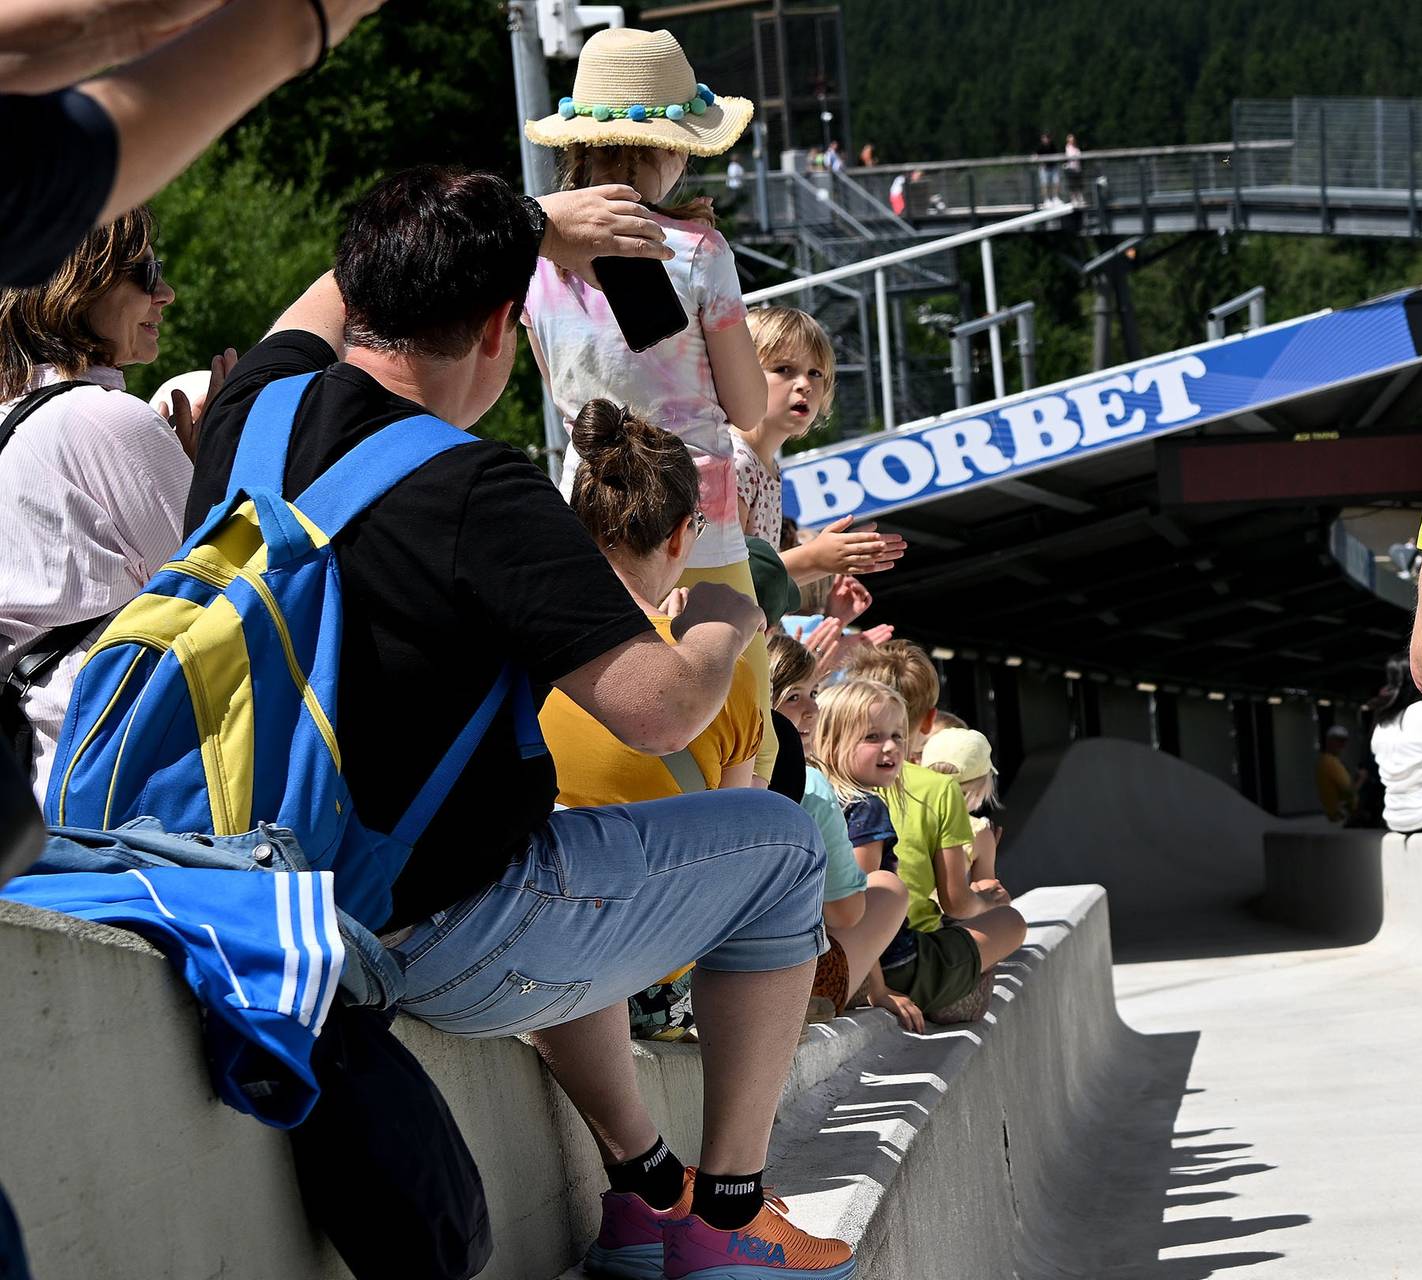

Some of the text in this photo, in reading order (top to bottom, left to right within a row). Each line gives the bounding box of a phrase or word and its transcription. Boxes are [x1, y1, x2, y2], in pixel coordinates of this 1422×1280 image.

[783, 355, 1207, 526] BORBET
[714, 1180, 755, 1195] PUMA
[727, 1231, 786, 1265] HOKA
